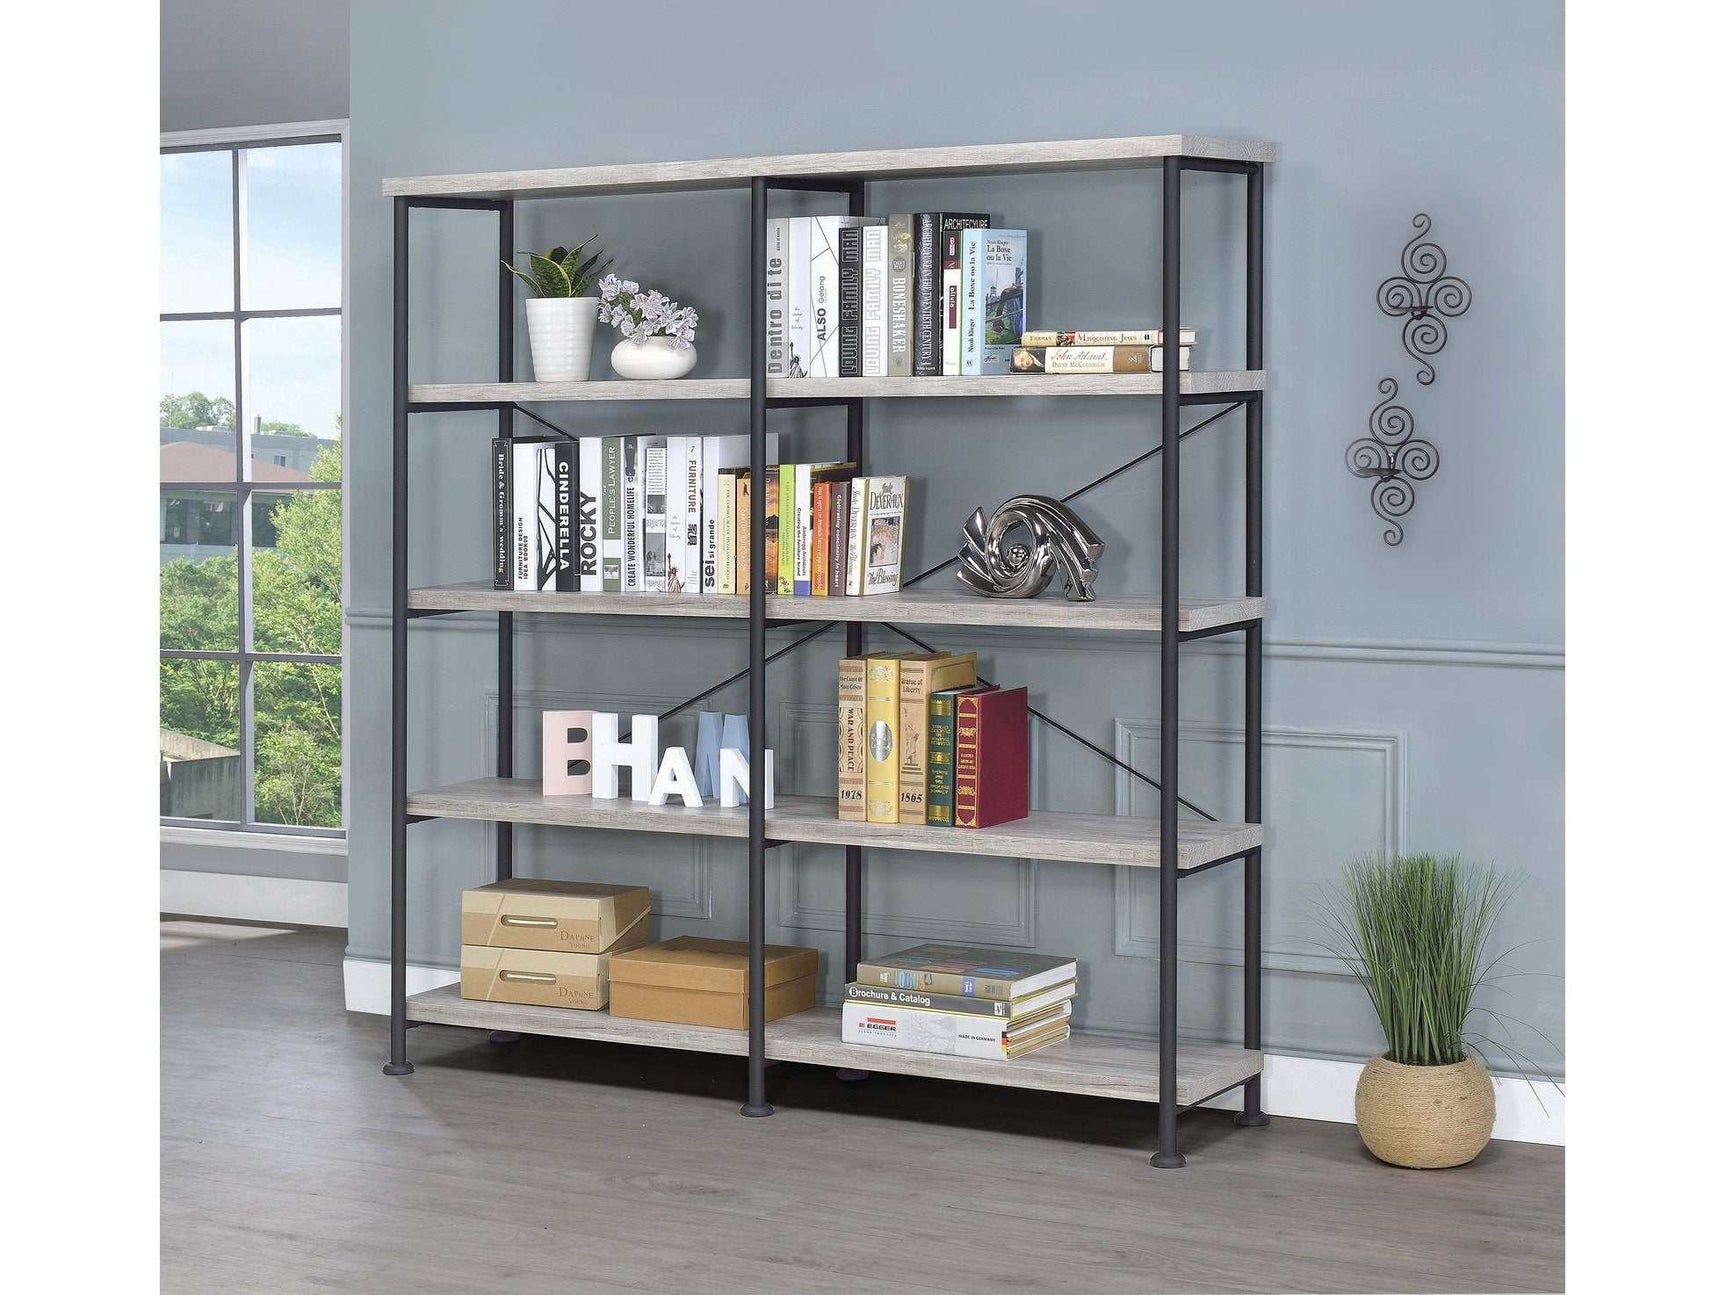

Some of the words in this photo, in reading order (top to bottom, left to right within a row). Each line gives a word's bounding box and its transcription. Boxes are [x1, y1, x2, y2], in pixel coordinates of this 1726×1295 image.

[767, 257, 783, 275] te
[767, 281, 783, 300] di
[817, 308, 827, 341] ALSO
[892, 278, 906, 353] BONESHAKER
[767, 308, 783, 374] Dentro
[608, 446, 616, 487] LAWYER
[687, 460, 696, 513] FURNITURE
[558, 461, 570, 571] CINDERELLA
[627, 487, 635, 520] HOMELIFE
[580, 491, 597, 576] ROCKY
[627, 520, 636, 562] WONDERFUL
[707, 519, 716, 549] grande
[627, 562, 636, 587] CREATE
[840, 789, 863, 801] 1978
[900, 792, 923, 804] 1865
[848, 986, 889, 1000] Brochure
[890, 991, 898, 1000] &
[898, 993, 931, 1007] Catalog
[866, 1023, 897, 1031] EGGER
